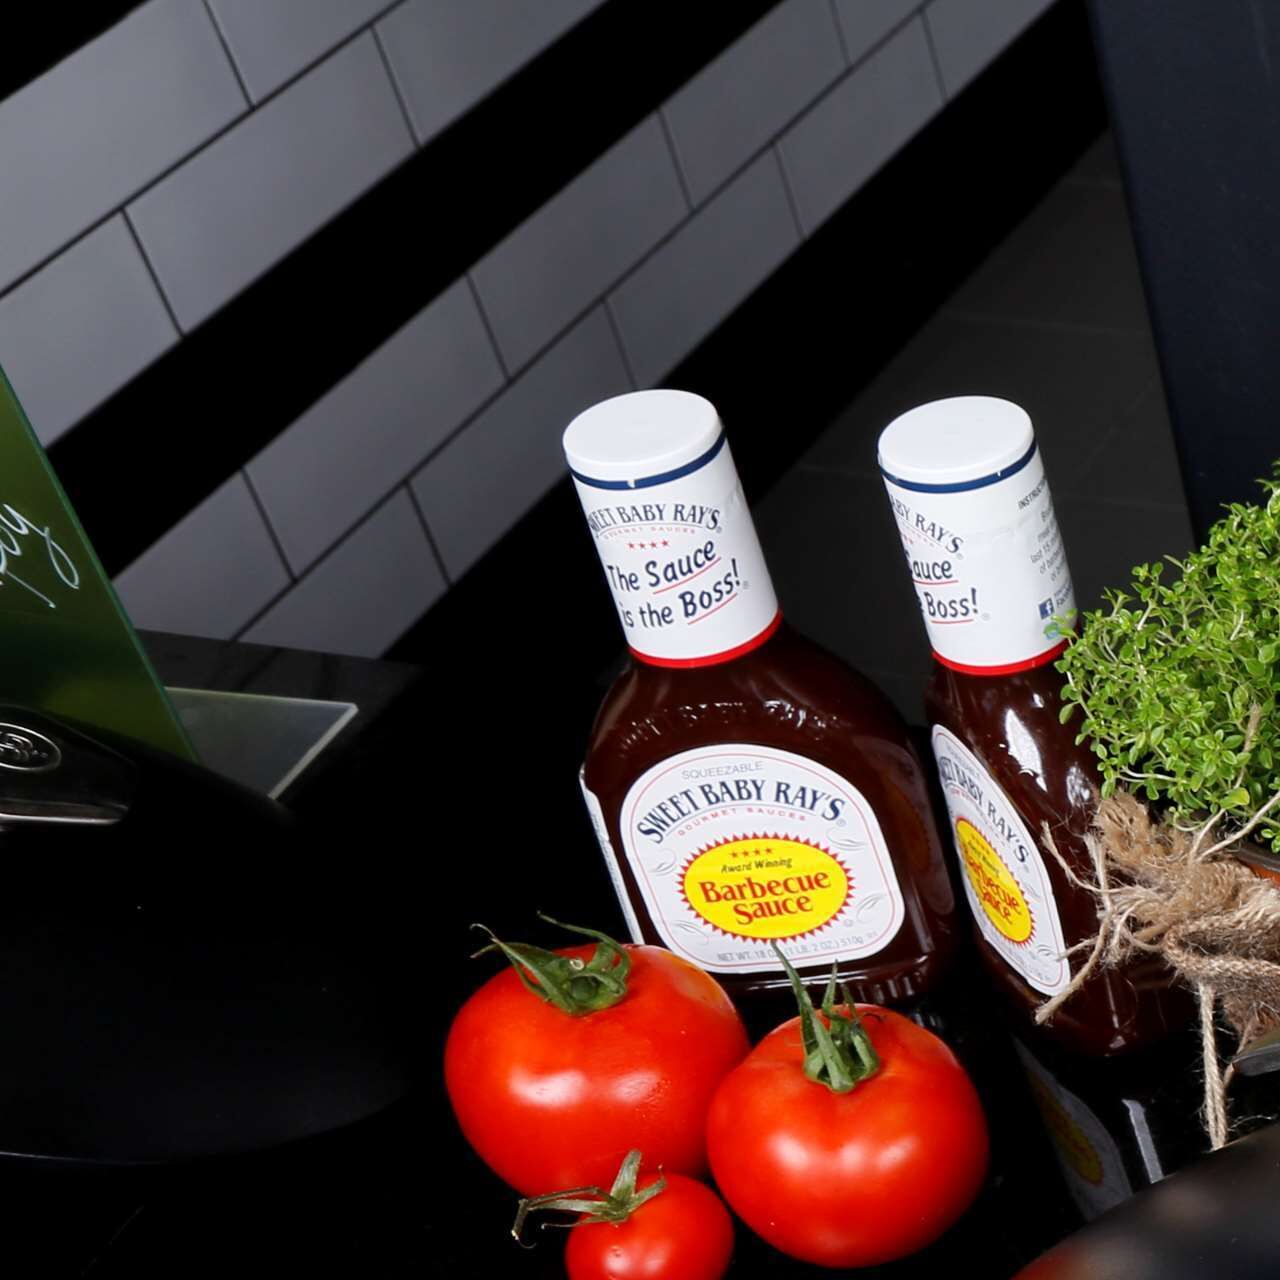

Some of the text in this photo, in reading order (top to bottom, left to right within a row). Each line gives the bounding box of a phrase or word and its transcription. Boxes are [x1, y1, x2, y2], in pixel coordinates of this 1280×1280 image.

[616, 503, 666, 523] BABY
[673, 503, 720, 530] RAY'S
[607, 540, 717, 592] The Sauce
[912, 560, 954, 581] auce
[619, 558, 741, 628] is the Boss!
[924, 587, 978, 618] Boss!
[681, 760, 765, 780] SQUEEZABLE
[637, 778, 846, 845] SWEET BABY RAY'S
[721, 858, 793, 874] Award Winning
[699, 872, 831, 903] Barbecue
[732, 896, 813, 925] Sauce
